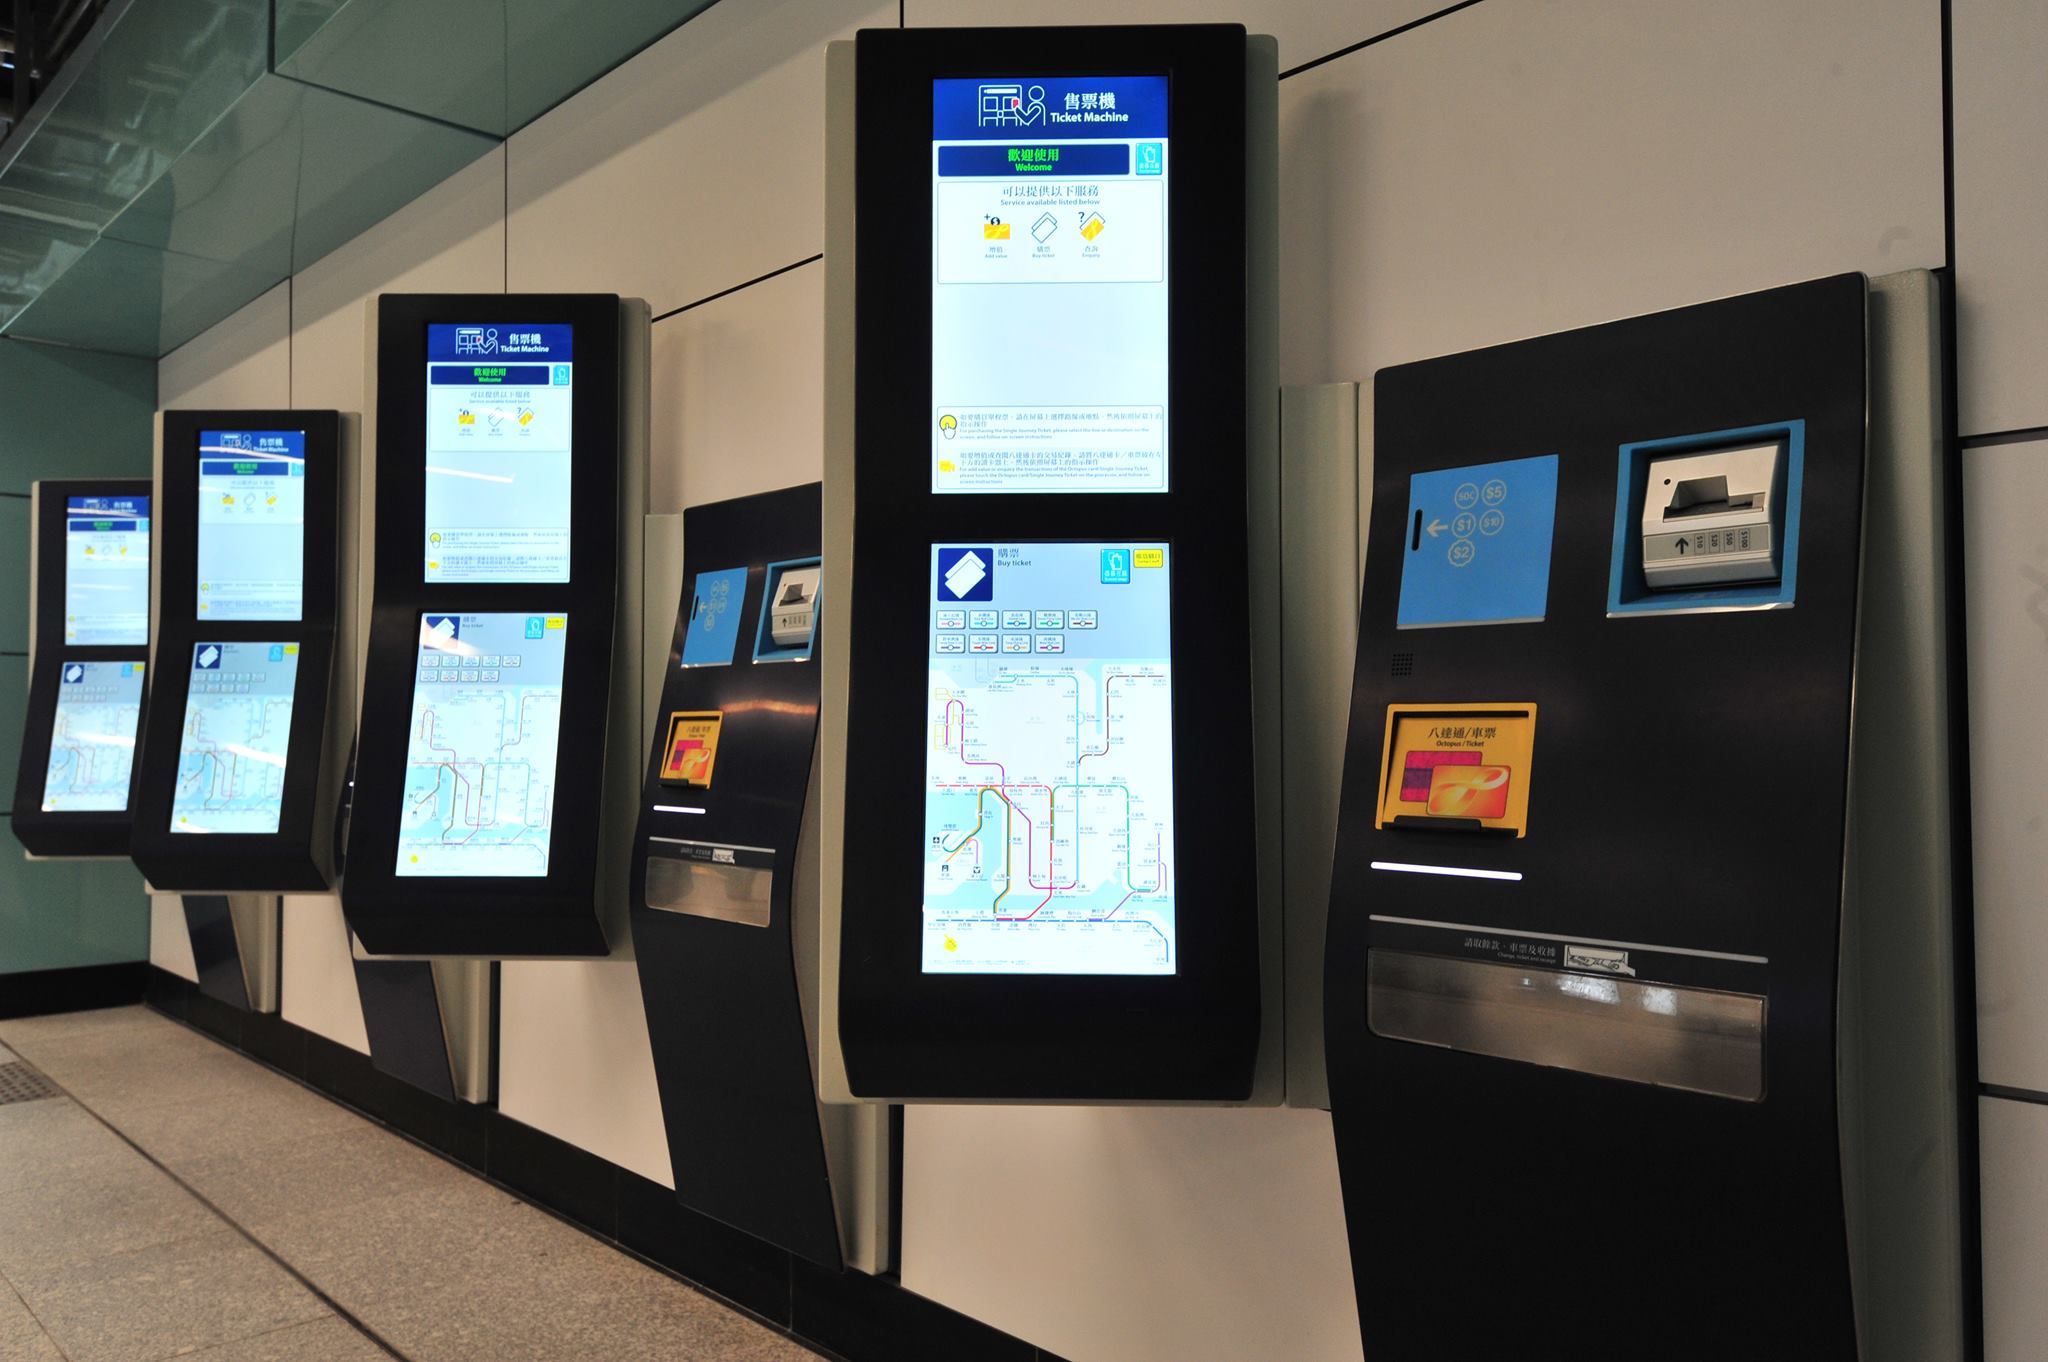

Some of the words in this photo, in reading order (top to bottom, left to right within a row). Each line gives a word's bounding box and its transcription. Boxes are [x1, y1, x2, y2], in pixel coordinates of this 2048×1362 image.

[1064, 92, 1116, 110] 售票機
[1050, 112, 1081, 122] Ticket
[1084, 111, 1129, 122] Machine
[1008, 148, 1059, 162] 歡迎使用
[1015, 163, 1052, 171] Welcome
[1003, 185, 1099, 197] 可以提供以下服務
[1428, 726, 1497, 739] 八達通/車票
